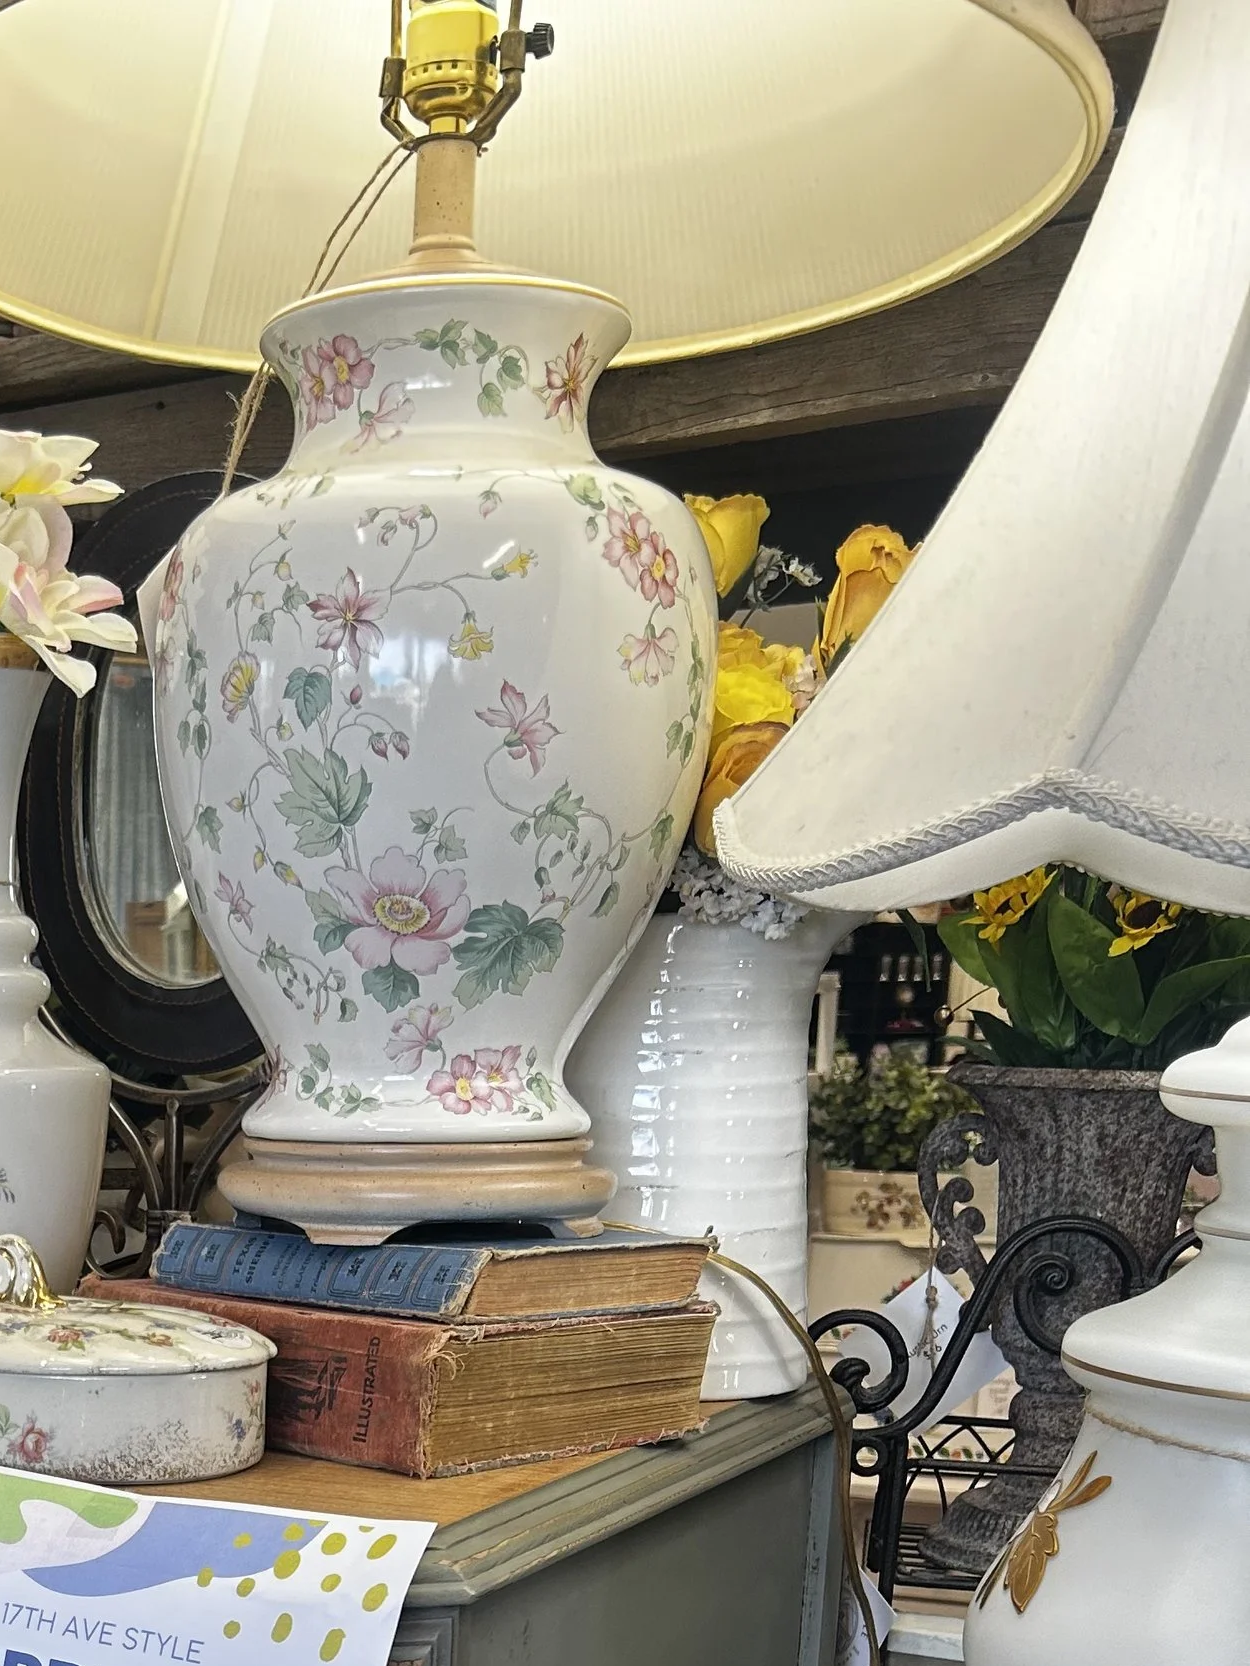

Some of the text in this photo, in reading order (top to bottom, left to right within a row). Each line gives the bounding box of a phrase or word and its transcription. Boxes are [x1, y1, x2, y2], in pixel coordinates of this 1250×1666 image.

[351, 1335, 382, 1446] ILLUSTRATED
[1, 1602, 206, 1666] 17TH AVE STYLE
